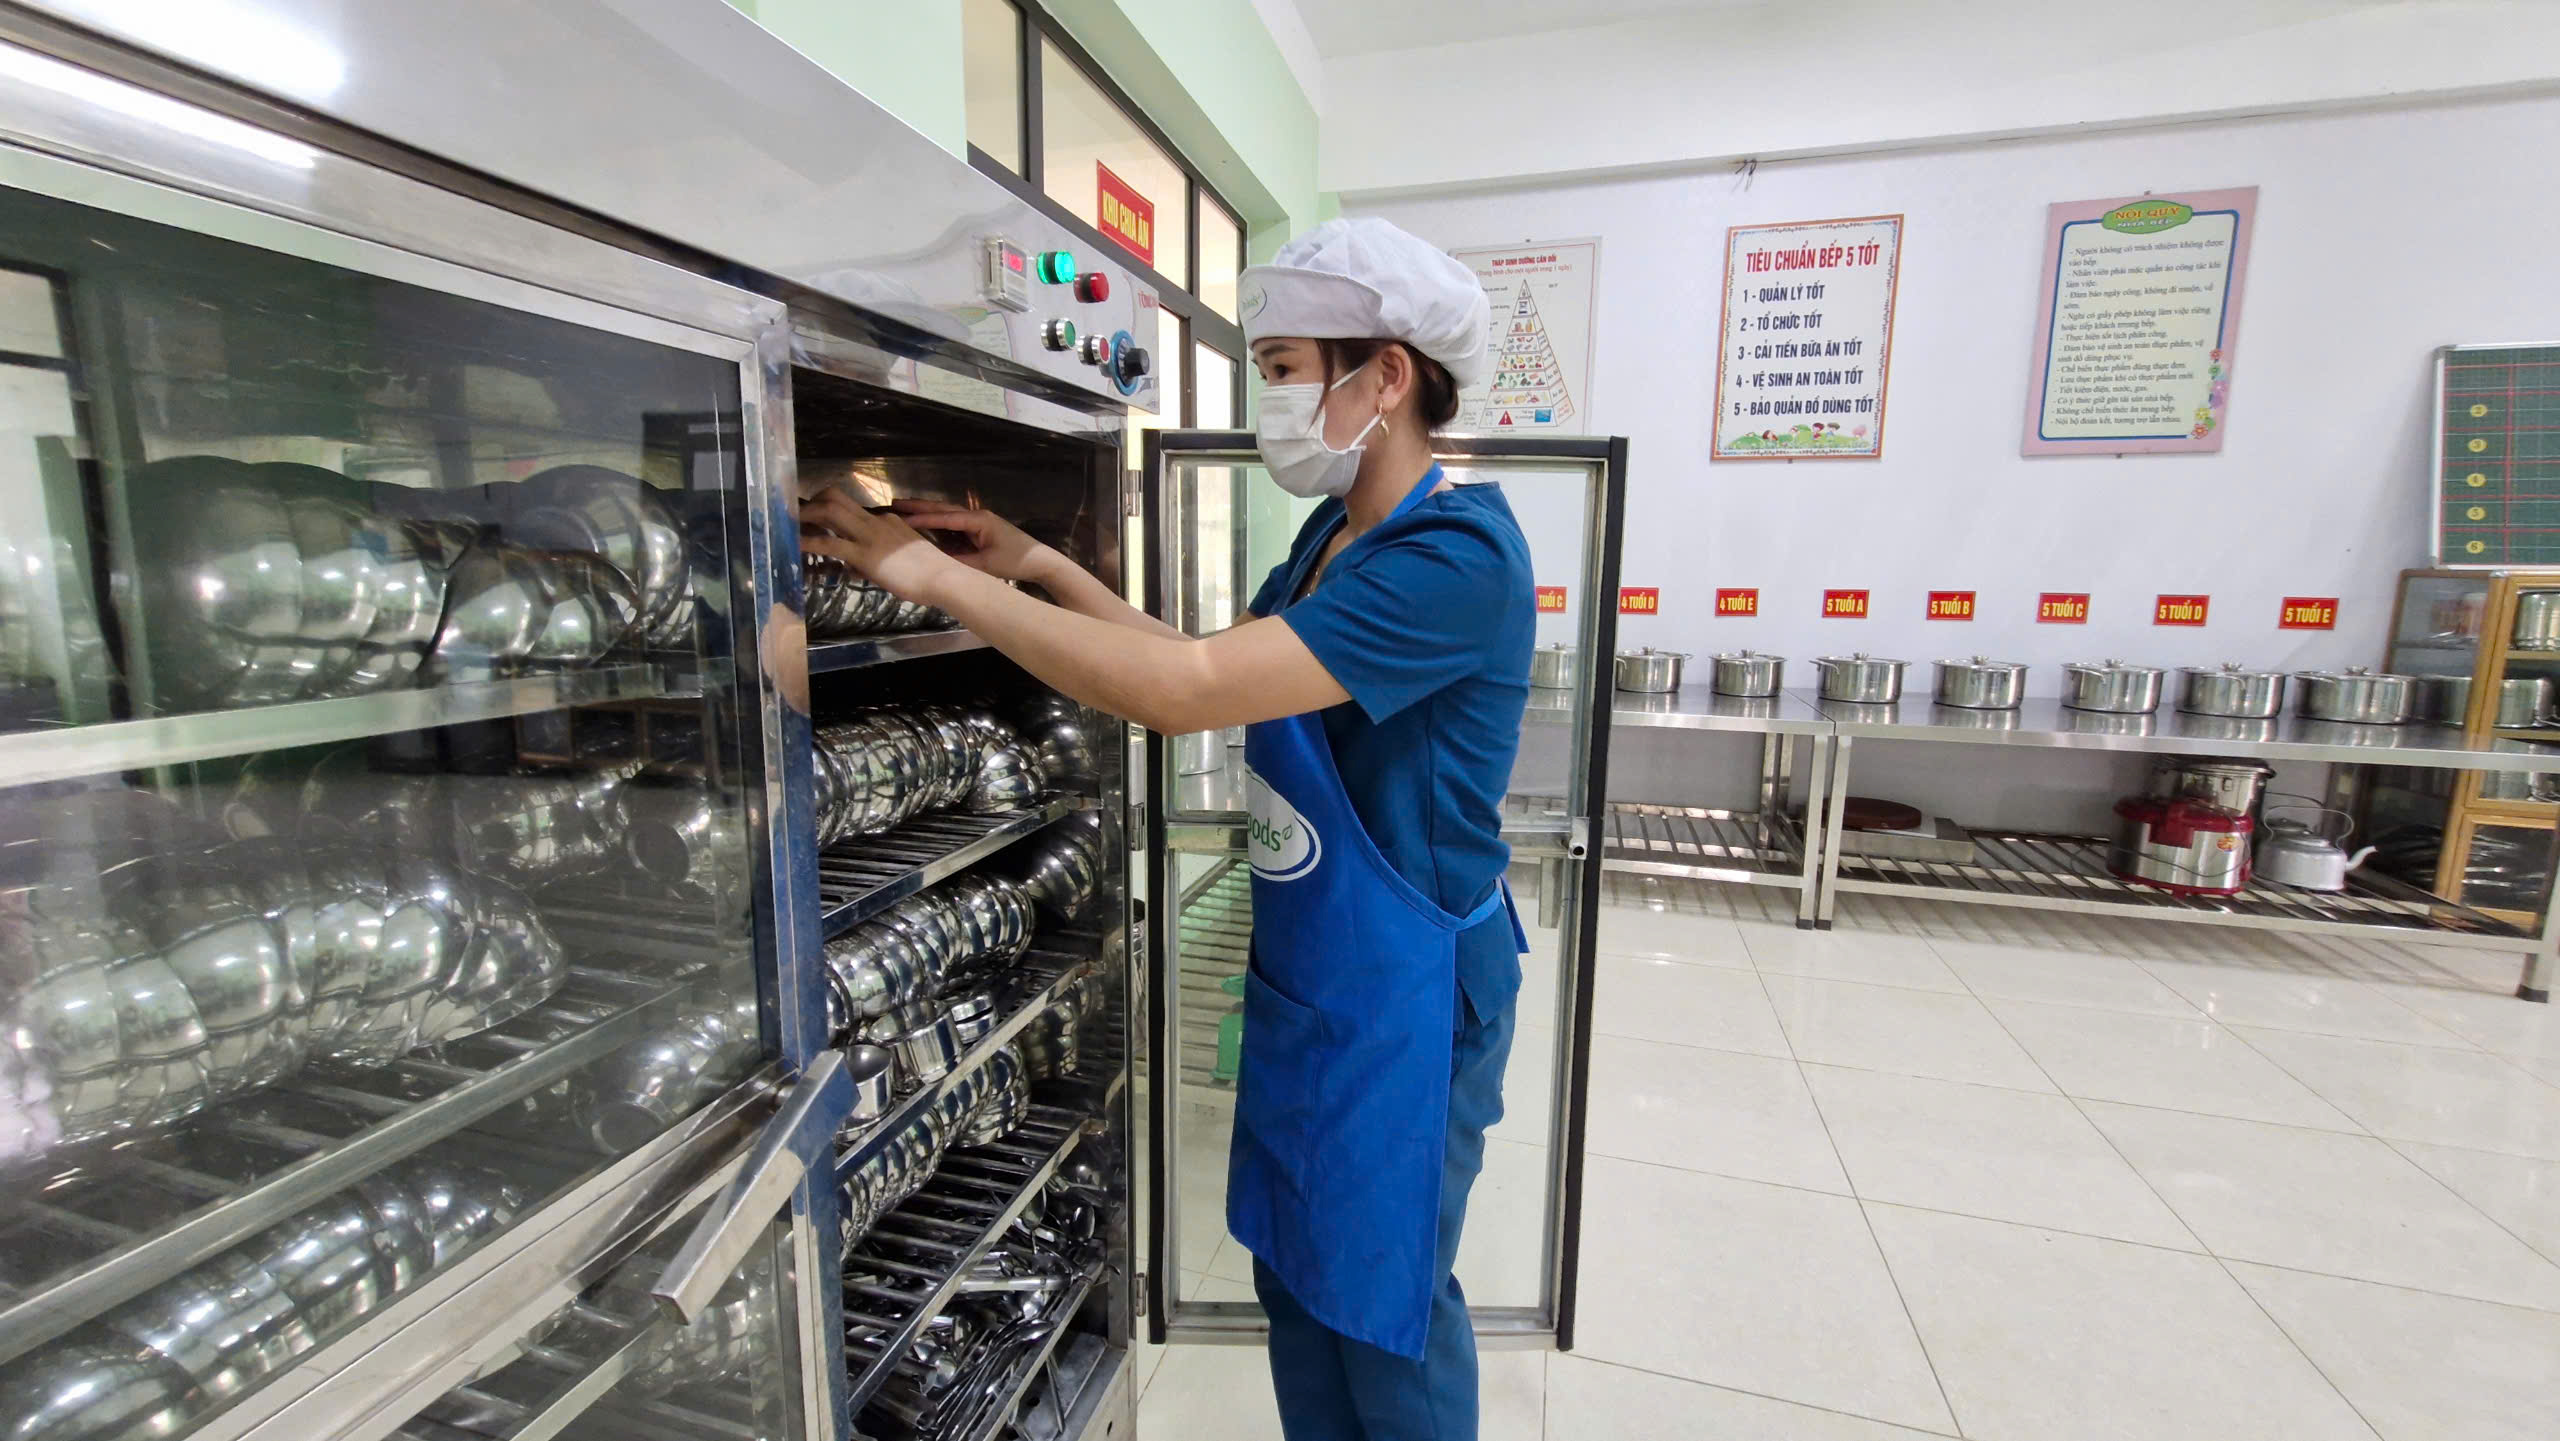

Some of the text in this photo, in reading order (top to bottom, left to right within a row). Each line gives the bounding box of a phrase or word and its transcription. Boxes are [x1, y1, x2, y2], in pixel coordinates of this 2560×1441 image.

[1103, 189, 1148, 250] KHU CHIA ĂN
[2116, 207, 2179, 218] NỘI QUY
[1747, 236, 1880, 272] TIÊU CHUẨN BẾP 5 TỐT
[1744, 290, 1748, 303] 1
[1759, 281, 1788, 303] QUẢN
[1790, 283, 1803, 300] LÝ
[1806, 280, 1825, 300] TỐT
[1740, 318, 1747, 331] 2
[1758, 311, 1771, 330] TỔ
[1772, 312, 1800, 330] CHỨC
[1804, 309, 1822, 328] TỐT
[1738, 346, 1744, 360] 3
[1755, 339, 1772, 359] CẢI
[1775, 339, 1798, 358] TIẾN
[1801, 340, 1821, 357] BỮA
[1825, 340, 1840, 356] ĂN
[1844, 336, 1862, 356] TỐT
[1736, 375, 1742, 387] 4
[1753, 371, 1765, 390] VỆ
[1768, 373, 1793, 387] SINH
[1796, 372, 1810, 386] AN
[1814, 368, 1841, 385] TOÀN
[1844, 365, 1863, 384] TỐT
[1734, 402, 1740, 415] 5
[1750, 396, 1770, 415] BẢO
[1774, 395, 1802, 416] QUẢN
[1805, 395, 1820, 414] ĐỒ
[1822, 397, 1851, 413] DÙNG
[1854, 394, 1874, 412] TỐT
[1538, 590, 1563, 607] TUỔI C
[1621, 592, 1654, 609] 4 TUỔI D
[1720, 592, 1753, 610] 4 TUỔI E
[1827, 594, 1863, 612] 5 TUỔI A
[1931, 596, 1970, 614] 5 TUỔI B
[2042, 598, 2083, 617] 5 TUỔI C
[2159, 600, 2202, 619] 5 TUỔI D
[2285, 602, 2331, 623] 5 TUỔI E
